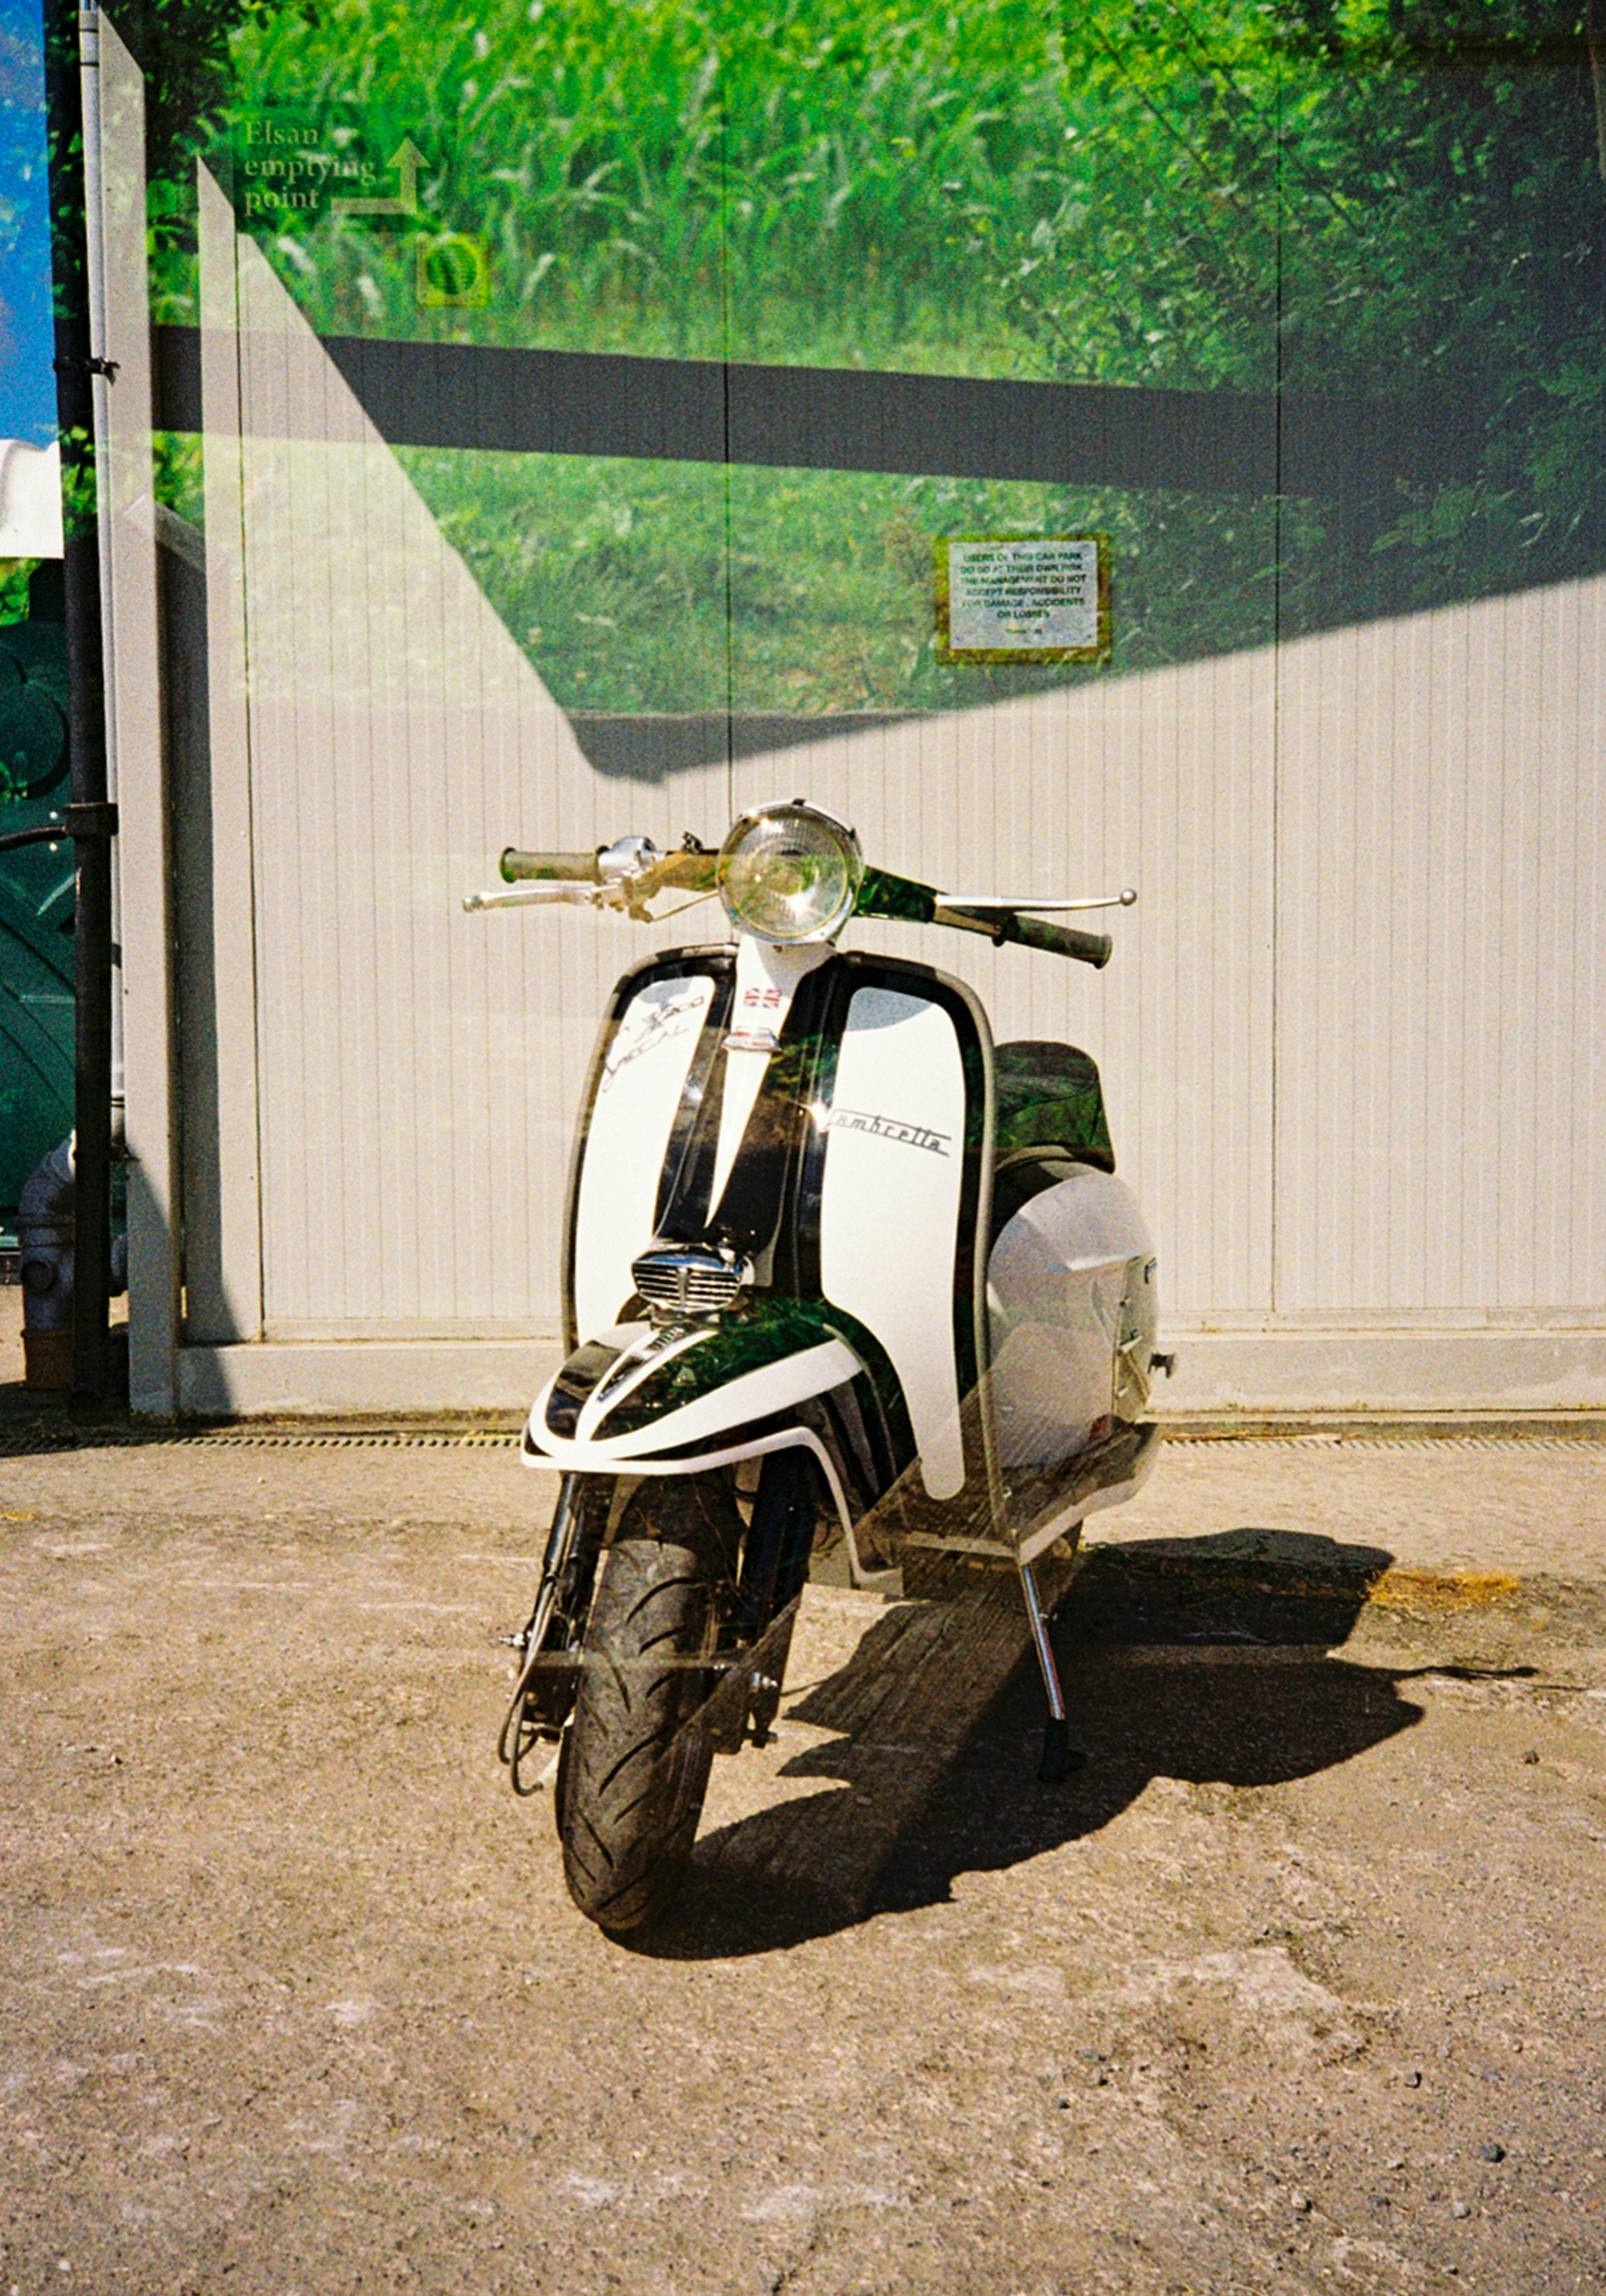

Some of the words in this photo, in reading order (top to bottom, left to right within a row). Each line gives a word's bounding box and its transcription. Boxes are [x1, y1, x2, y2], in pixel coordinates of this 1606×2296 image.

[245, 120, 319, 145] Elsan
[245, 157, 376, 186] emptying
[245, 187, 319, 216] point
[1035, 553, 1056, 561] CAR
[1058, 552, 1083, 560] PARK
[960, 566, 975, 574] DO
[1050, 575, 1064, 583] DO
[1067, 575, 1086, 583] NOT
[997, 610, 1011, 618] OR
